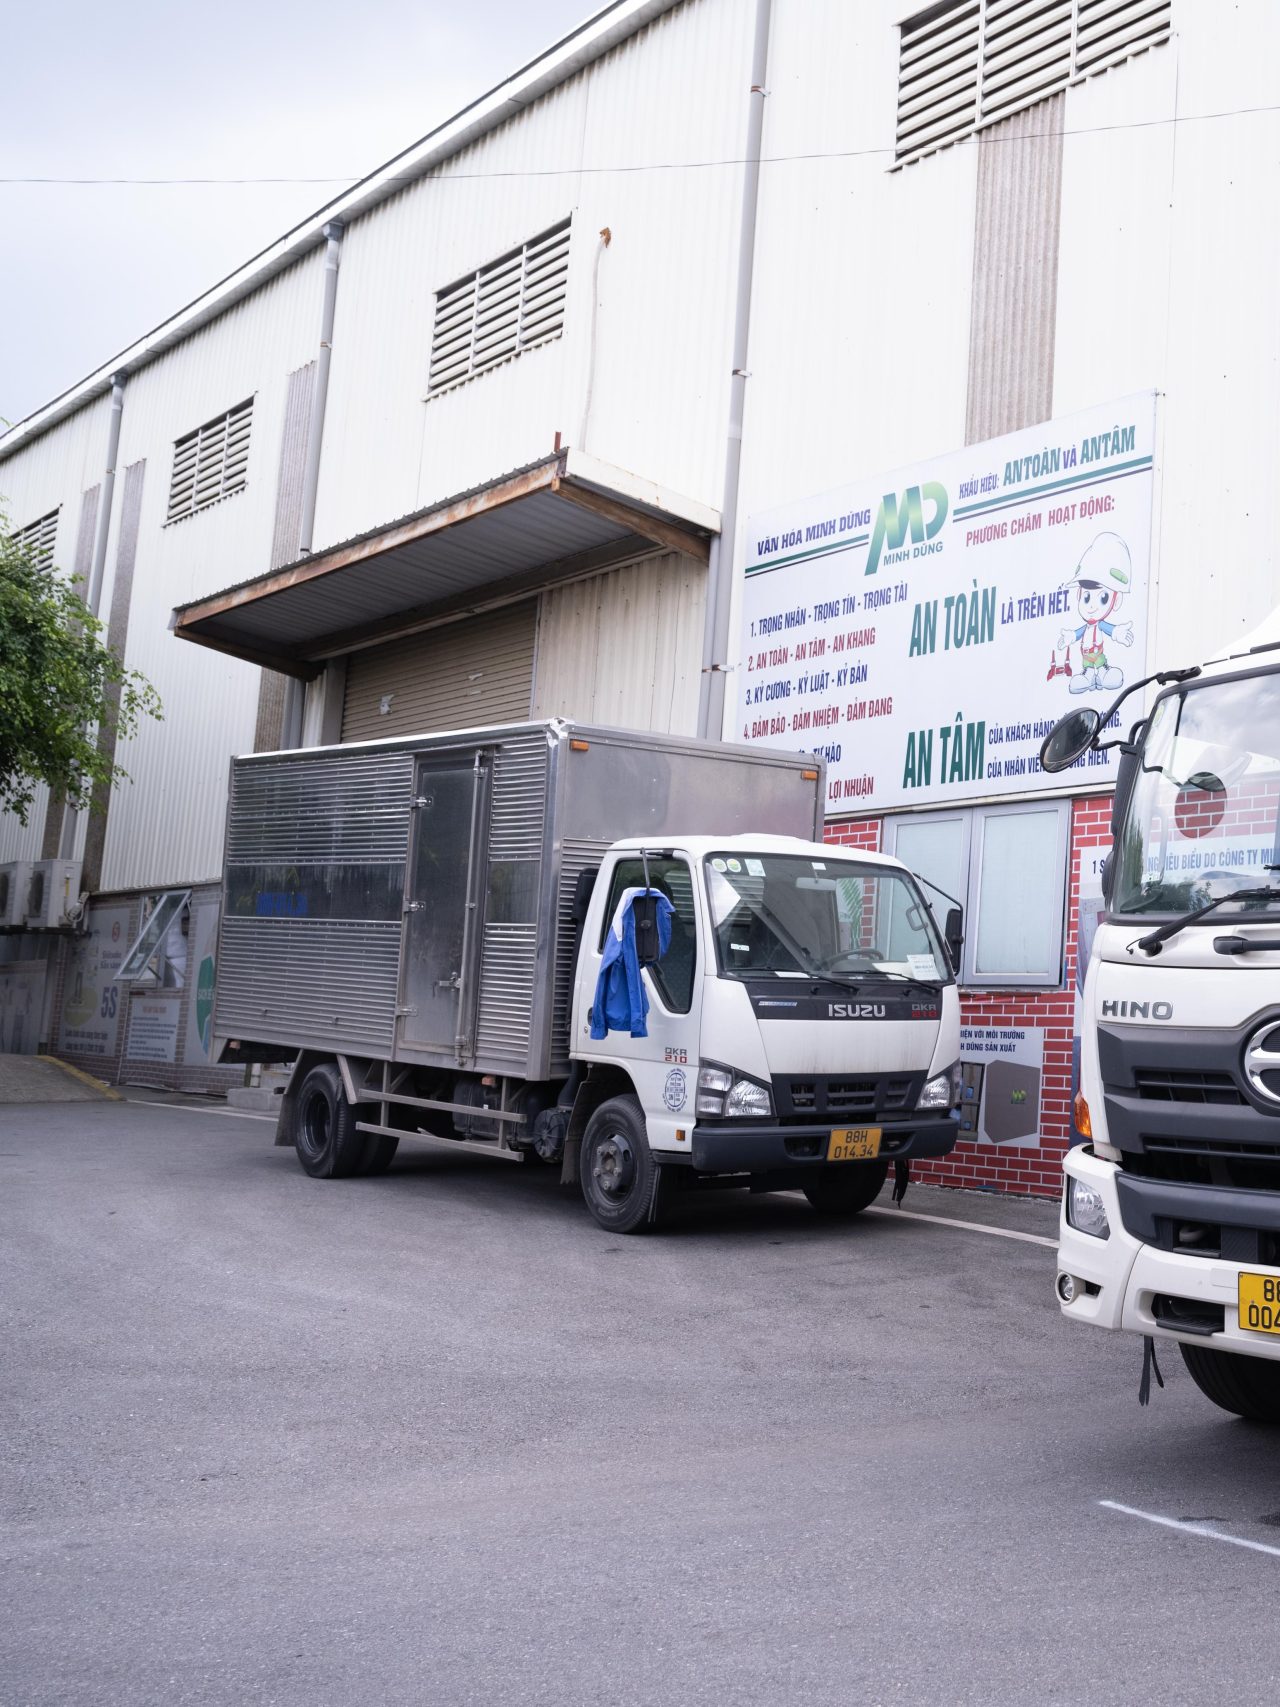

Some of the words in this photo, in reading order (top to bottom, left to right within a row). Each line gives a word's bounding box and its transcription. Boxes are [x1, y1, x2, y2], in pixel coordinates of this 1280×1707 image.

[959, 474, 978, 500] KHẨU
[980, 473, 1000, 494] HIỆU:
[1063, 444, 1077, 470] VÀ
[758, 536, 778, 556] VĂN
[781, 528, 802, 549] HÓA
[806, 520, 836, 543] MINH
[839, 509, 871, 533] DŨNG
[966, 522, 1007, 547] PHƯƠNG
[1011, 512, 1042, 535] CHÂM
[1048, 504, 1077, 526] HOẠT
[1080, 495, 1115, 520] ĐỘNG:
[884, 549, 910, 566] MINH
[913, 541, 944, 558] DŨNG
[750, 622, 757, 638] 1.
[759, 615, 782, 637] TRỌNG
[784, 606, 806, 629] NHÂN
[814, 602, 840, 624] TRỌNG
[842, 593, 855, 616] TÍN
[864, 589, 891, 612] TRỌNG
[894, 580, 908, 602] TÀI
[908, 600, 938, 658] AN
[944, 579, 996, 651] TOÀN
[1001, 596, 1014, 624] LÀ
[1018, 591, 1044, 622] TRÊN
[1048, 582, 1070, 615] HẾT.
[748, 656, 755, 672] 2.
[756, 651, 767, 670] AN
[769, 645, 788, 666] TOÀN
[795, 642, 806, 661] AN
[809, 636, 826, 658] TÂM
[832, 635, 844, 653] AN
[846, 627, 876, 650] KHANG
[746, 690, 752, 706] 3.
[766, 680, 791, 701] CƯƠNG
[810, 670, 830, 694] LUẬT
[850, 660, 868, 684] BẢN
[744, 724, 750, 740] 4.
[752, 715, 768, 738] ĐẢM
[770, 712, 786, 735] BẢO
[792, 707, 811, 732] ĐẢM
[812, 704, 839, 729] NHIỆM
[846, 697, 866, 722] ĐẢM
[868, 697, 892, 718] ĐANG
[989, 722, 1003, 744] CỦA
[1006, 722, 1031, 742] KHÁCH
[902, 729, 933, 789] AN
[940, 712, 986, 784] TÂM
[988, 756, 1002, 778] CỦA
[1004, 756, 1026, 776] NHÂN
[844, 774, 874, 799] NHUẬN
[1092, 860, 1096, 874] 1
[1166, 852, 1180, 870] IÊU
[1204, 852, 1216, 868] DO
[1220, 848, 1244, 866] CÔNG
[1247, 849, 1258, 864] TY
[101, 986, 118, 1018] 5S
[828, 1004, 886, 1018] ISUZU
[1102, 1000, 1174, 1020] HINO
[665, 1047, 687, 1056] QKR
[665, 1055, 687, 1064] 210
[846, 1130, 868, 1143] 88H
[834, 1144, 874, 1158] 014.34
